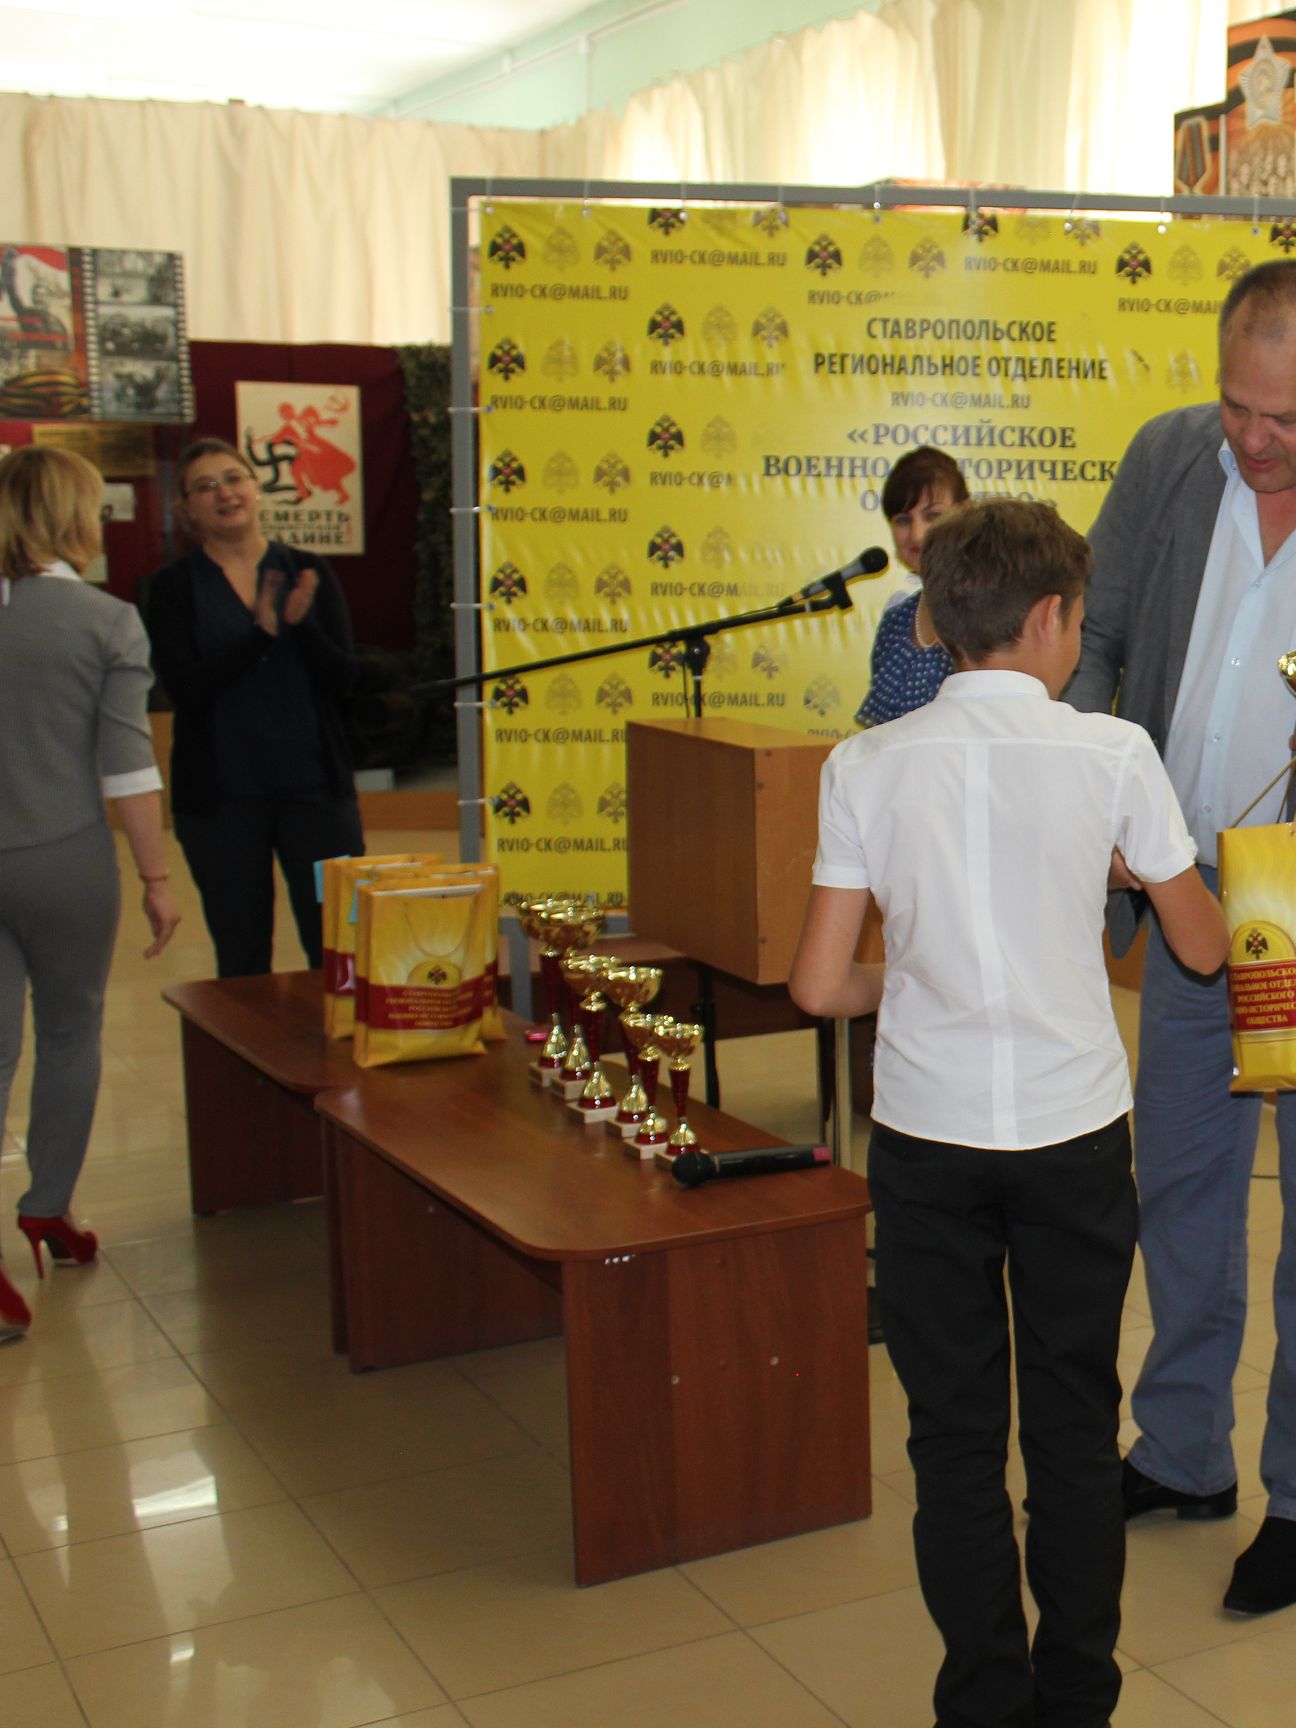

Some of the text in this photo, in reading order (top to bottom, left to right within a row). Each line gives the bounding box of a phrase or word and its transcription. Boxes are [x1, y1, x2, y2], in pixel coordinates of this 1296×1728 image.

[650, 250, 787, 267] RVIO-CK@MAIL.RU
[964, 256, 1098, 274] RVIO-CK@MAIL.RU
[491, 283, 629, 300] RVIO-CK@MAIL.RU
[867, 317, 1057, 342] СТАВРОПОЛЬСКОЕ
[813, 352, 1108, 381] РЕГИОНАЛЬНОЕ ОТДЕЛЕНИЕ
[891, 391, 1031, 409] RVIO-CK@MAIL.RU
[846, 419, 1078, 448] «РОССИЙСКОЕ
[491, 507, 629, 524] RVIO-CK@MAIL.RU
